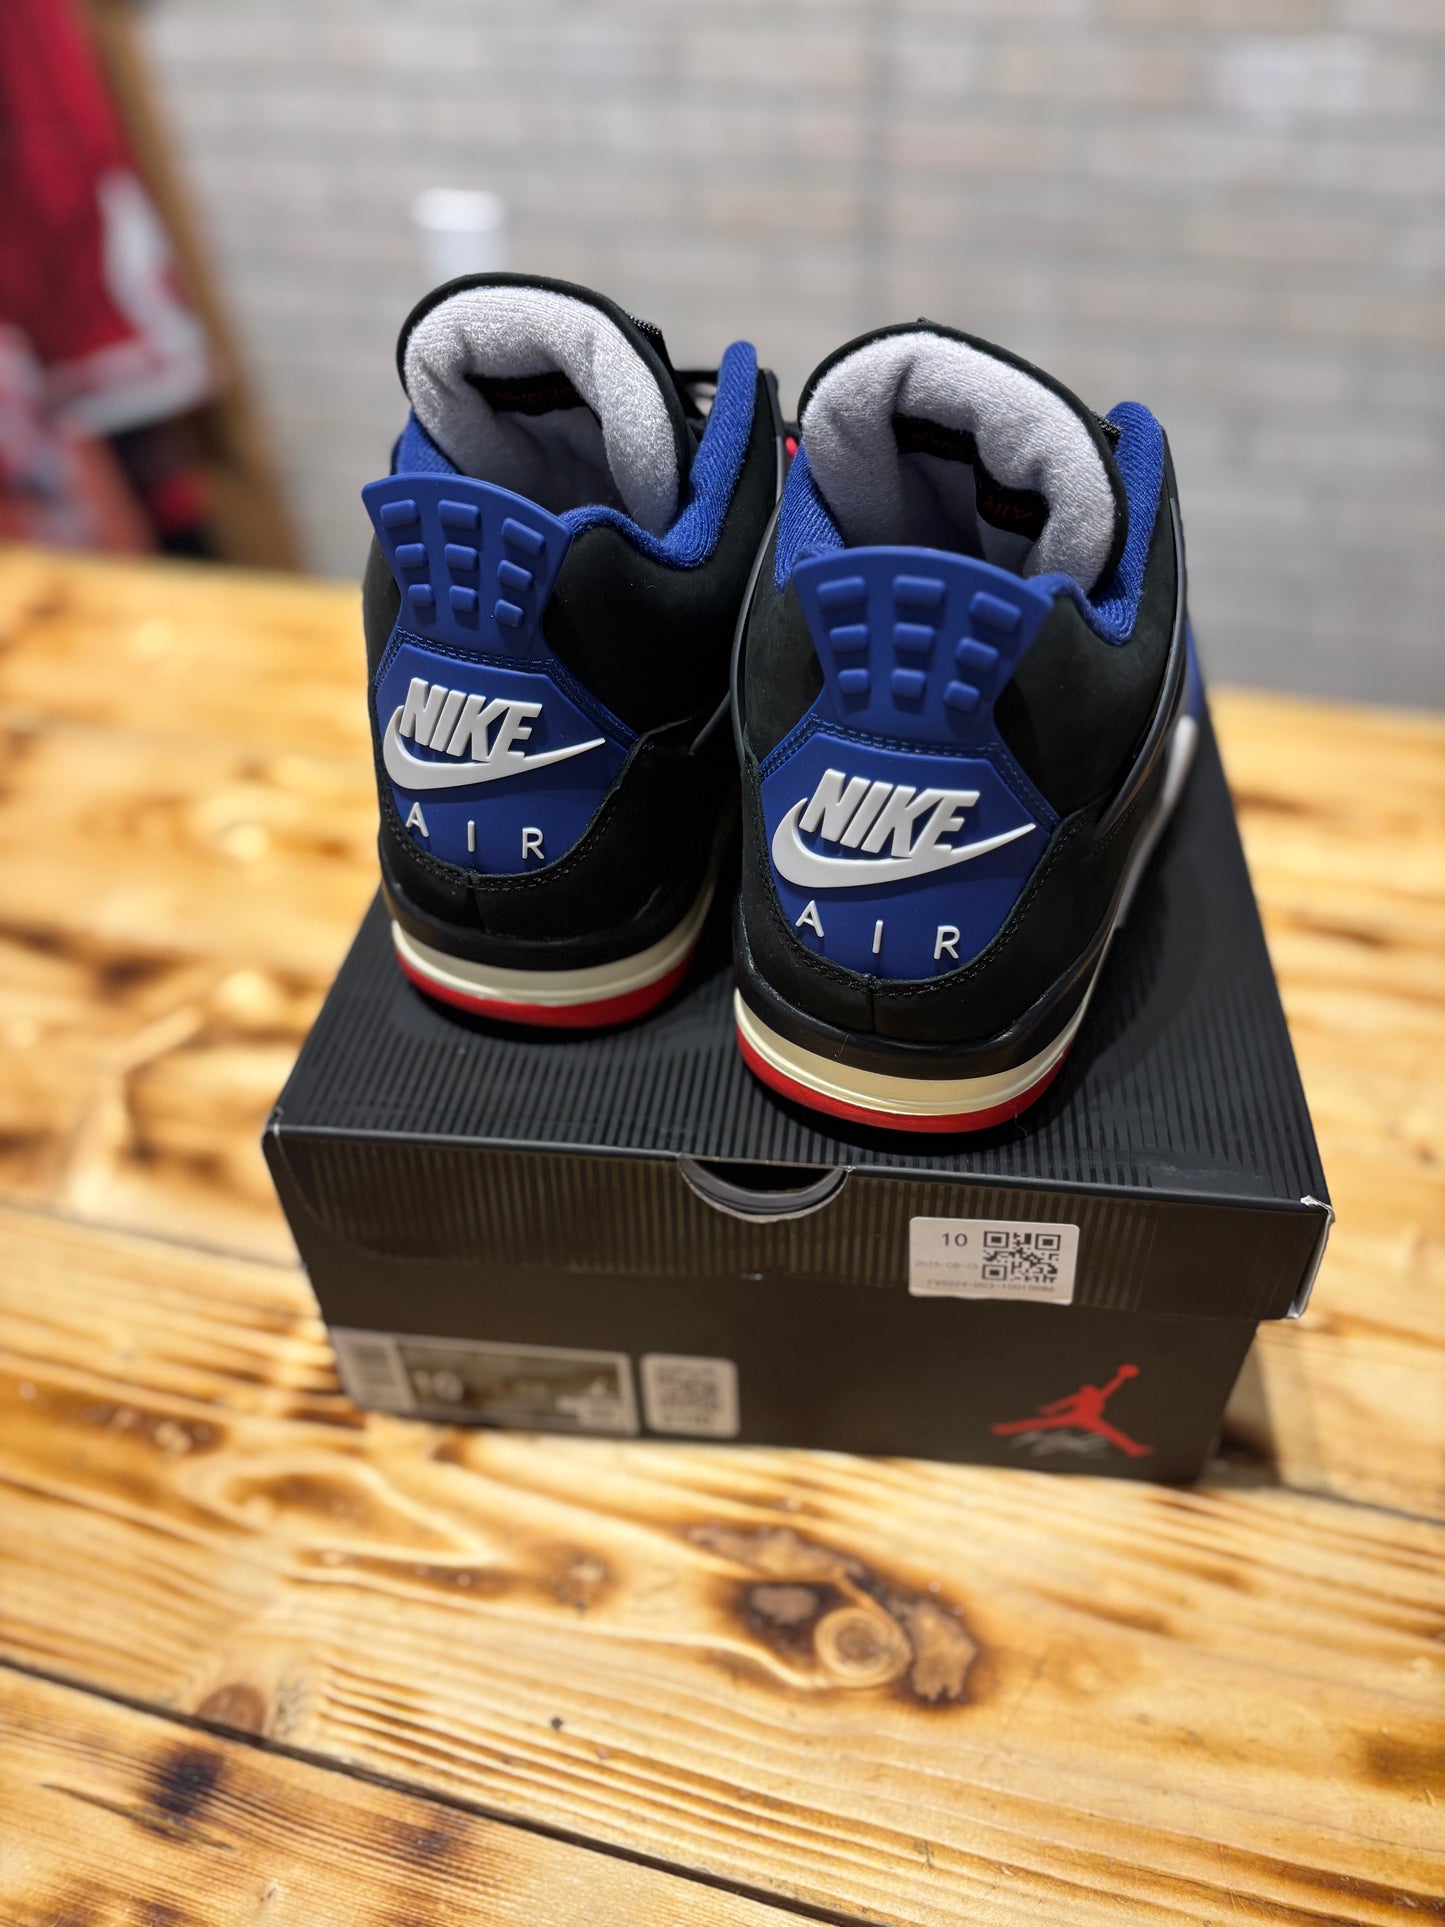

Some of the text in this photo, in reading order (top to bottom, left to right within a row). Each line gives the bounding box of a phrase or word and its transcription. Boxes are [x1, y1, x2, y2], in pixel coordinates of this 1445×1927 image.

[400, 677, 543, 763] NIKE
[405, 801, 545, 860] AIR
[799, 768, 980, 858] NIKE
[795, 900, 961, 960] AIR
[942, 1232, 968, 1247] 10
